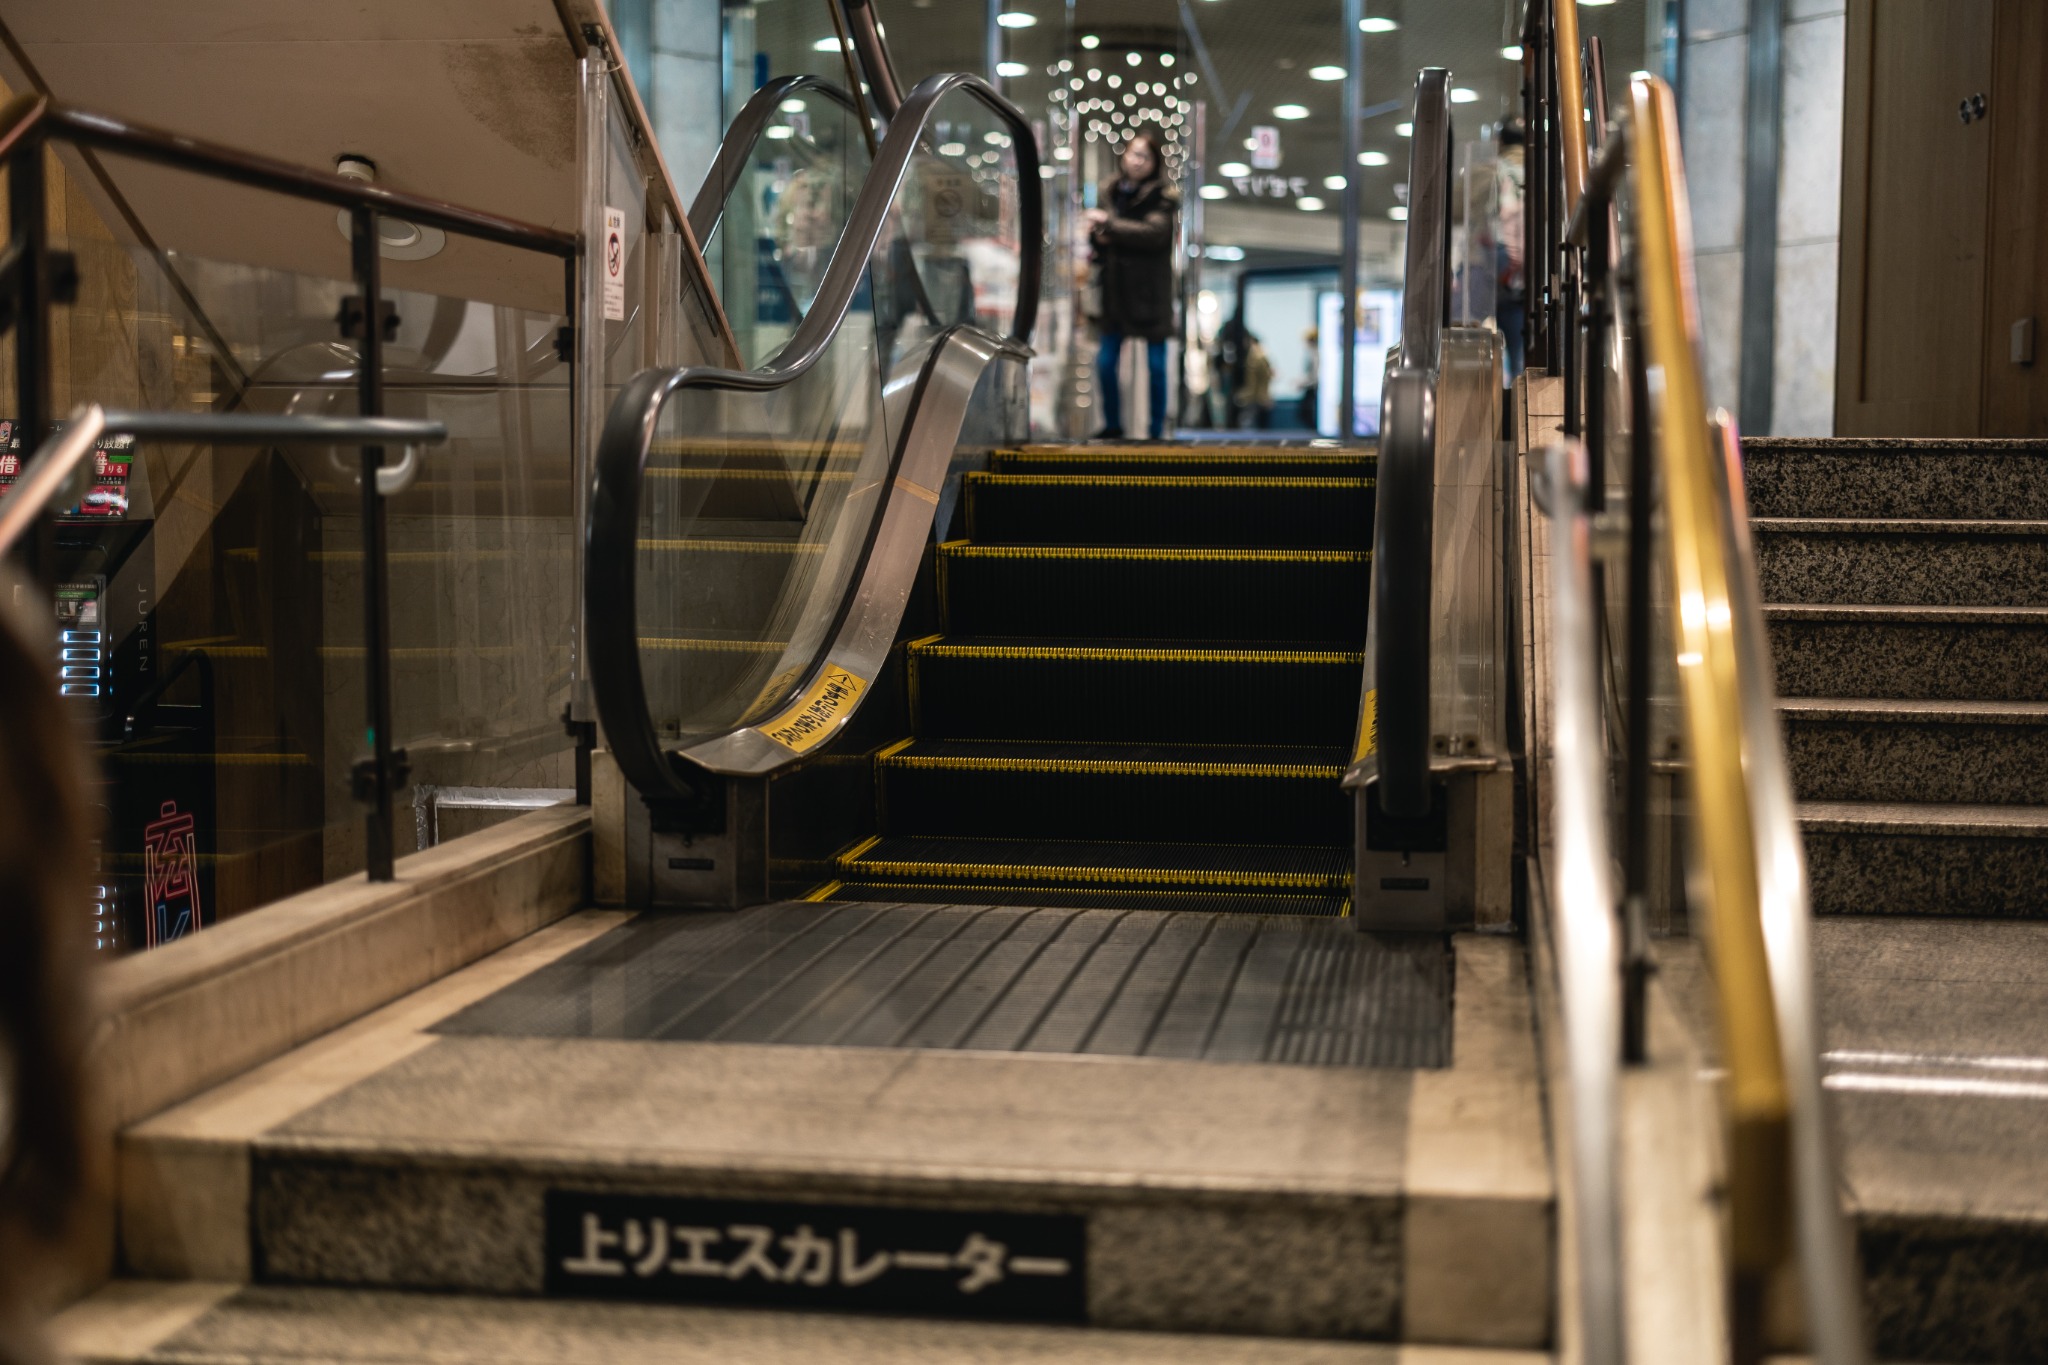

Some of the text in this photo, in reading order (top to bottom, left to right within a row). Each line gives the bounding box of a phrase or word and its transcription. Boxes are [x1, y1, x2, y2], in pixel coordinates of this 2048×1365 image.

[138, 583, 148, 672] JUREN
[562, 1212, 1070, 1294] 上りエスカレーター
